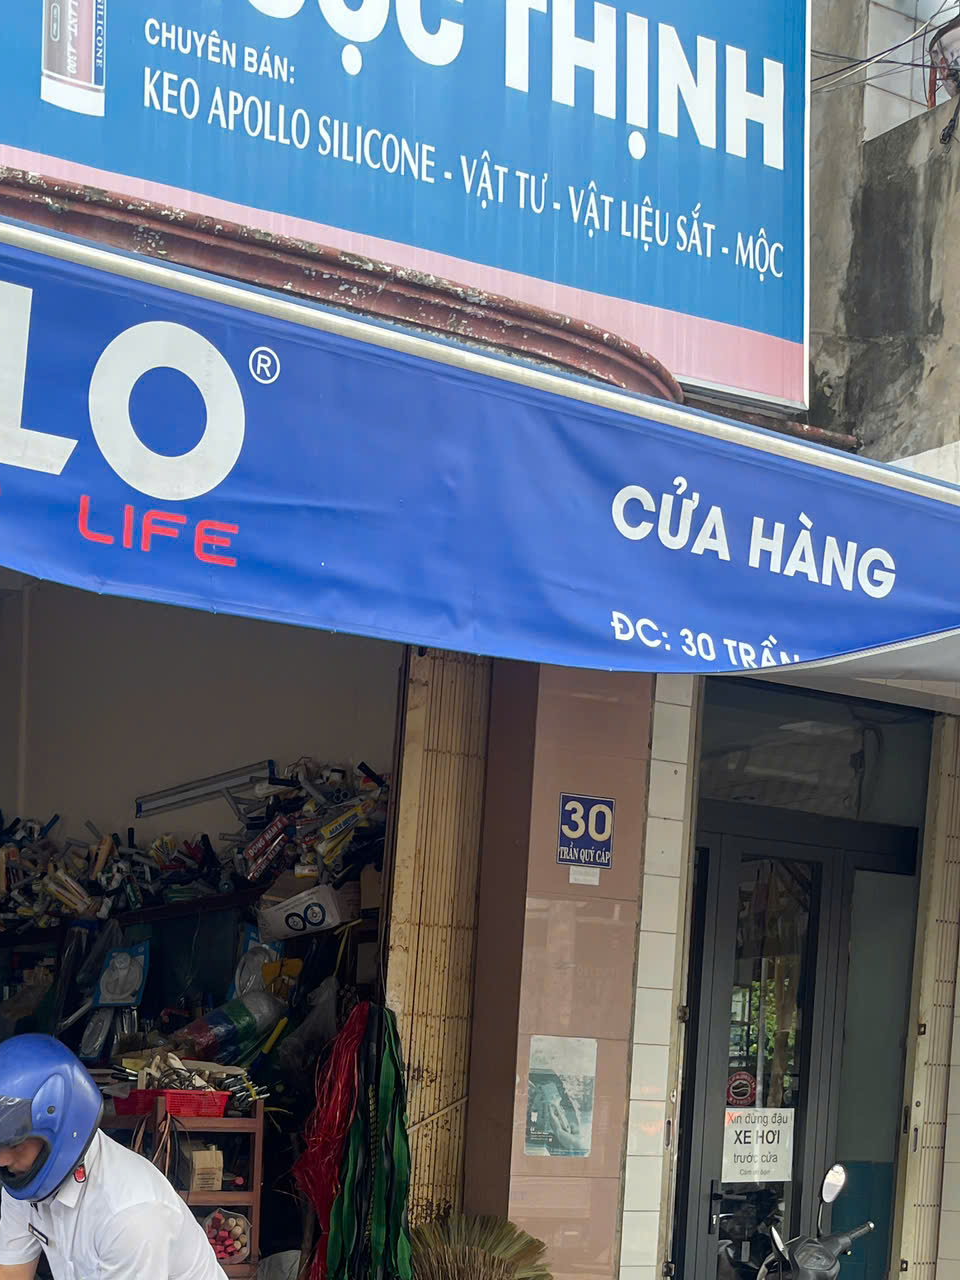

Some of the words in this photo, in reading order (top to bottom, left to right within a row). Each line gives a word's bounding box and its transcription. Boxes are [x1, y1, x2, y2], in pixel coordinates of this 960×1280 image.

[144, 18, 237, 69] CHUYÊN
[243, 45, 296, 84] BÁN:
[504, 0, 784, 171] THỊNH
[143, 66, 201, 120] KEO
[207, 86, 311, 150] APOLLO
[318, 115, 436, 184] SILICONE
[460, 150, 508, 210] VẬT
[515, 170, 548, 214] TƯ
[568, 180, 614, 238] VẬT
[621, 195, 669, 252] LIỆU
[676, 203, 716, 258] SẮT
[735, 227, 784, 282] MỘC
[78, 495, 239, 567] LIFE
[611, 476, 731, 561] CỬA
[748, 512, 897, 599] HÀNG
[610, 610, 672, 651] ĐC:
[679, 628, 717, 662] 30
[561, 800, 613, 842] 30
[580, 846, 595, 864] QUÝ
[596, 848, 611, 864] CÁP
[727, 1113, 742, 1124] Xin
[771, 1112, 788, 1126] đậu
[734, 1130, 752, 1144] XE
[756, 1129, 780, 1144] HƠI
[733, 1152, 759, 1163] trước
[761, 1151, 778, 1163] cửa
